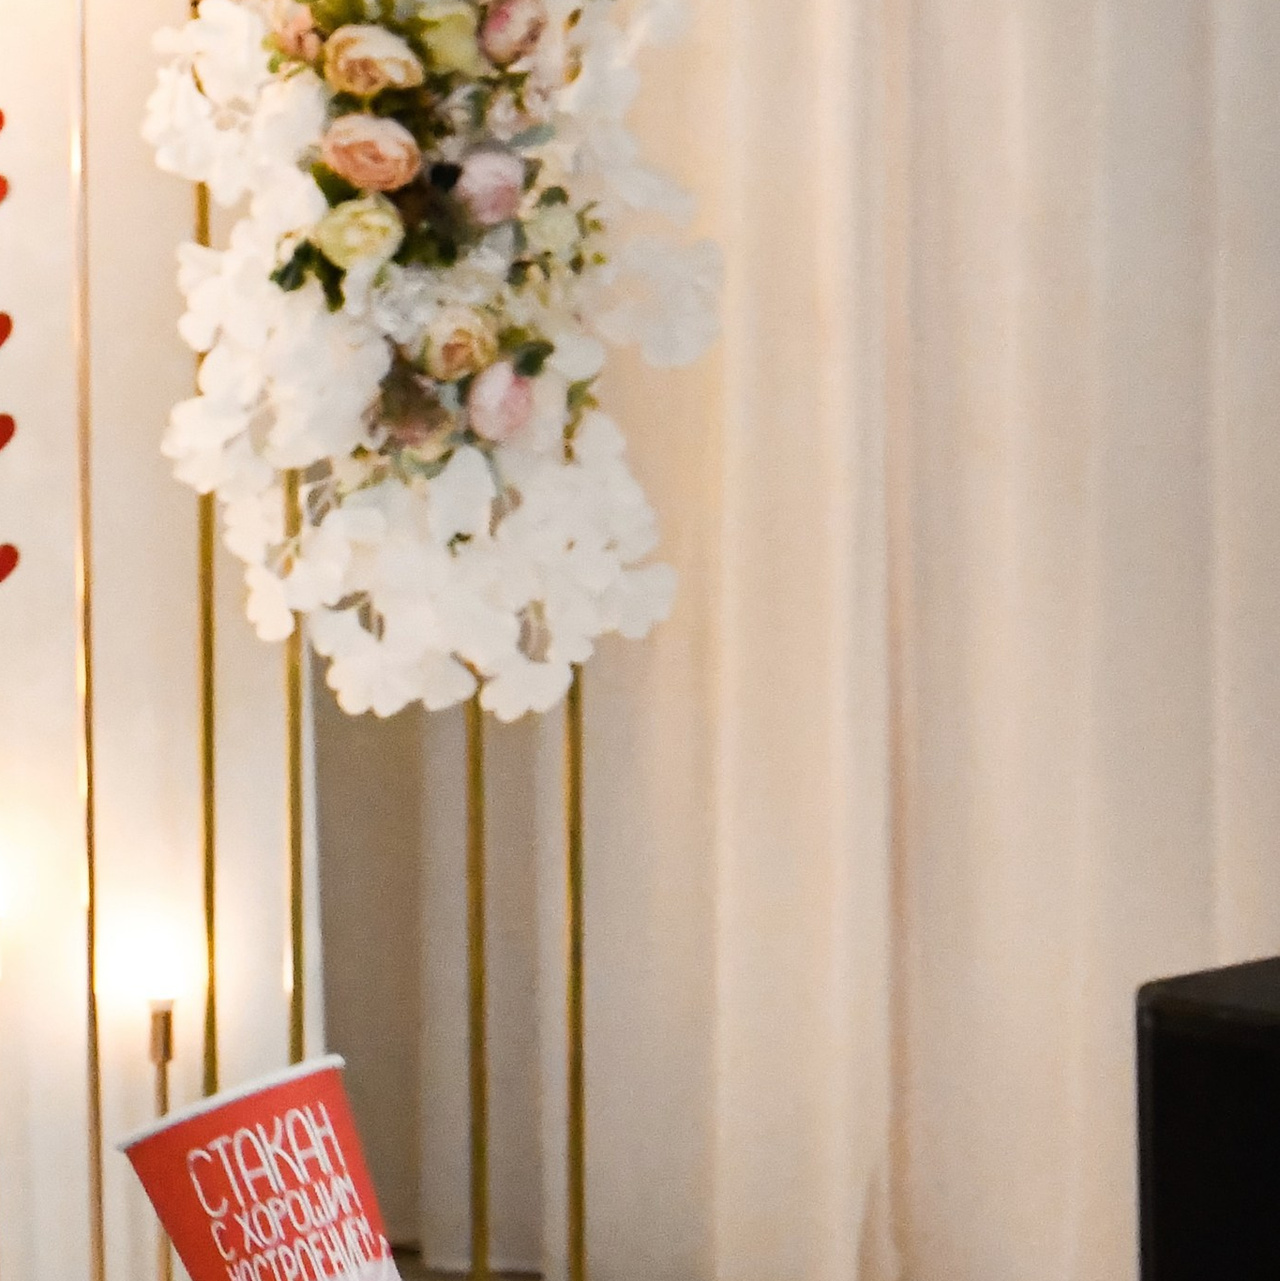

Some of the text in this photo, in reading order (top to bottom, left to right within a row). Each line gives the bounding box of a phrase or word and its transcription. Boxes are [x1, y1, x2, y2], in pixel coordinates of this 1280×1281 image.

[186, 1101, 346, 1219] СТАКАН
[210, 1173, 363, 1261] С ХОРОШИМ
